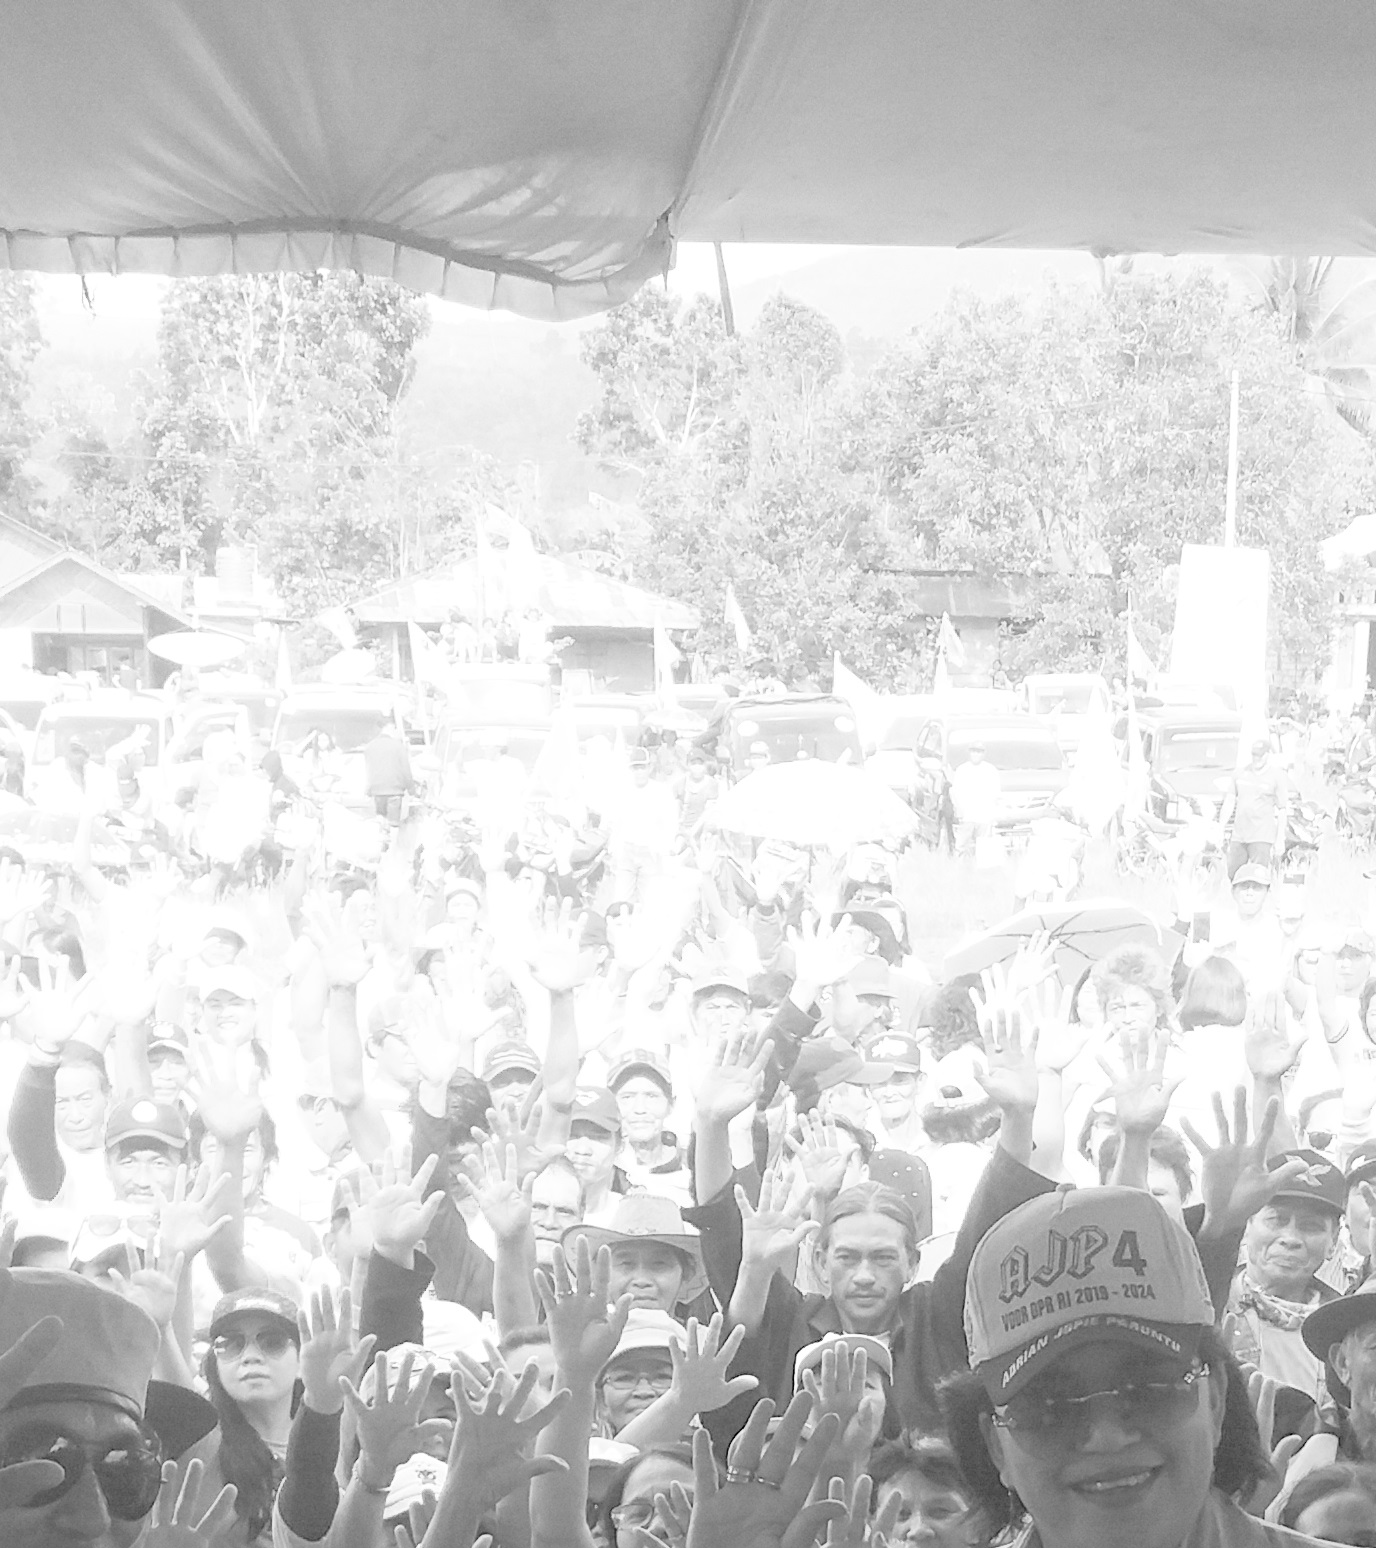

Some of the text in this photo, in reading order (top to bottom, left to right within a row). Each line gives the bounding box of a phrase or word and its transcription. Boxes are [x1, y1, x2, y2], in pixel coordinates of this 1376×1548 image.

[999, 1225, 1147, 1303] AJP 4
[1030, 1296, 1055, 1320] DPR
[1056, 1290, 1072, 1310] RI
[1075, 1285, 1109, 1304] 2019
[1001, 1335, 1049, 1389] ADRIAN
